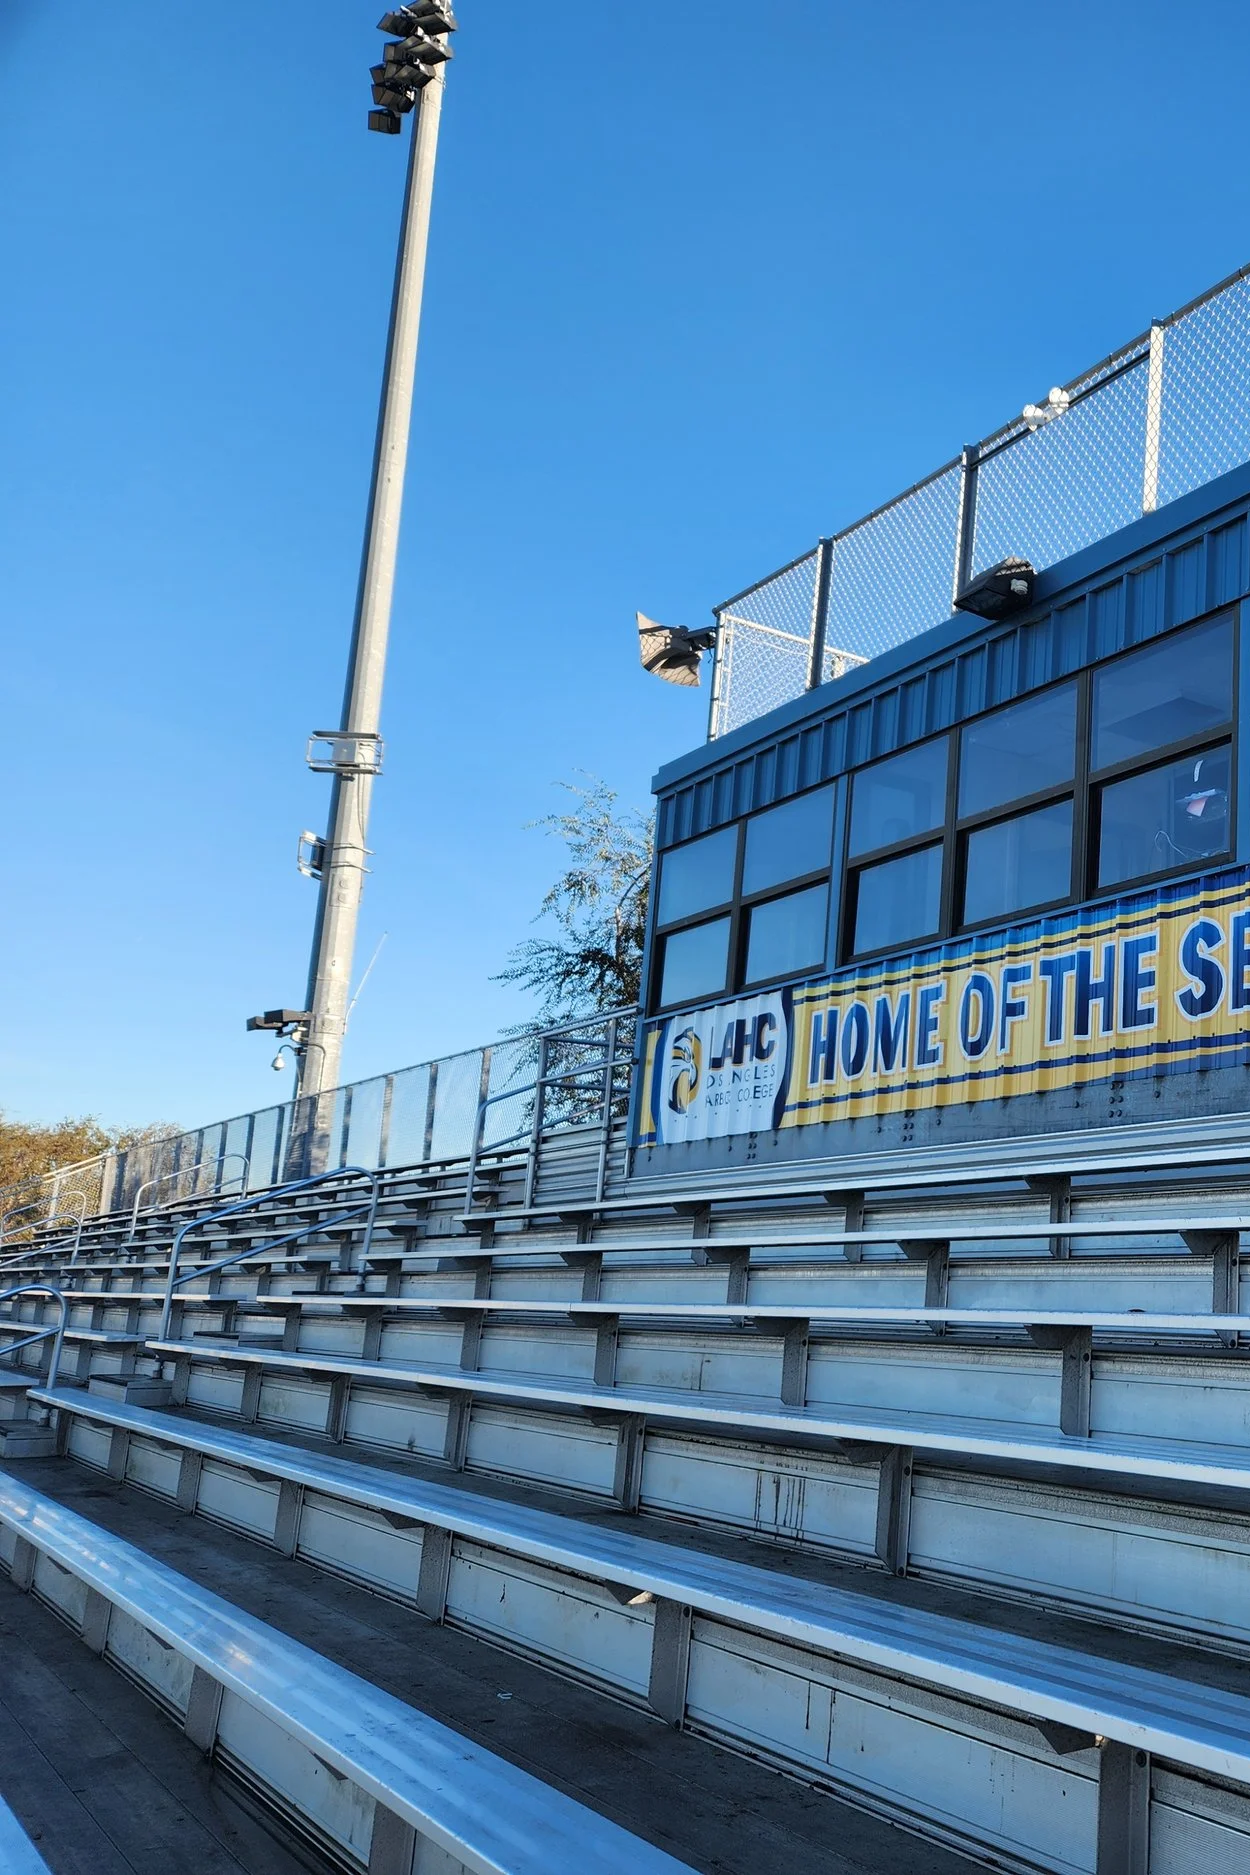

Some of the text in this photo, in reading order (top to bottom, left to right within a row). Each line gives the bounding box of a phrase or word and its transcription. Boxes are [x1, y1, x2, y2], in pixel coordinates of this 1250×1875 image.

[708, 1011, 777, 1070] LAHC
[808, 979, 947, 1088] HOME
[959, 960, 1034, 1061] OF
[1039, 929, 1160, 1047] THE
